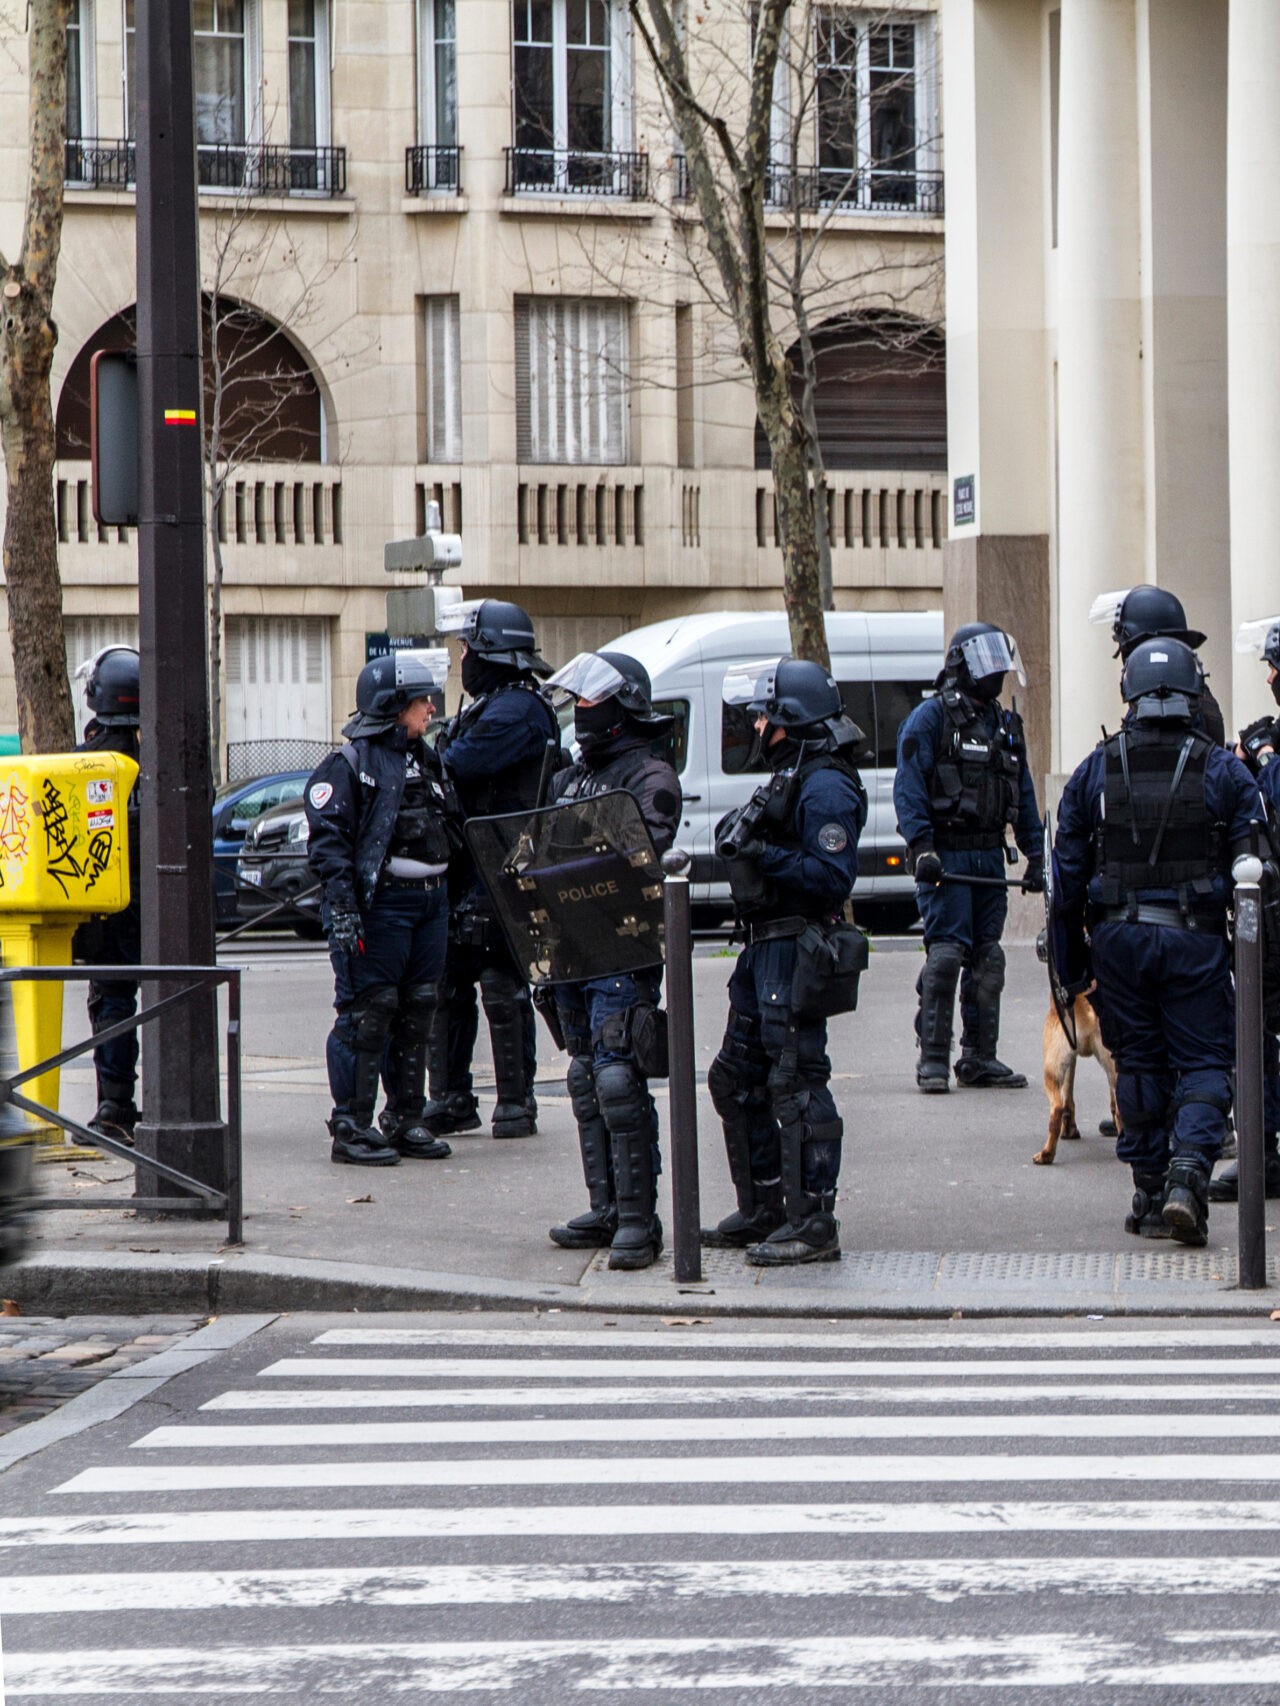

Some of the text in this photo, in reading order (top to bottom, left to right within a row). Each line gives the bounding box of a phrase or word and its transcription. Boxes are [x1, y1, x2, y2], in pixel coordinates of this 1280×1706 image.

[389, 637, 414, 647] AVENUE
[369, 647, 377, 656] DE
[379, 647, 388, 656] LA
[557, 880, 620, 904] POLICE
